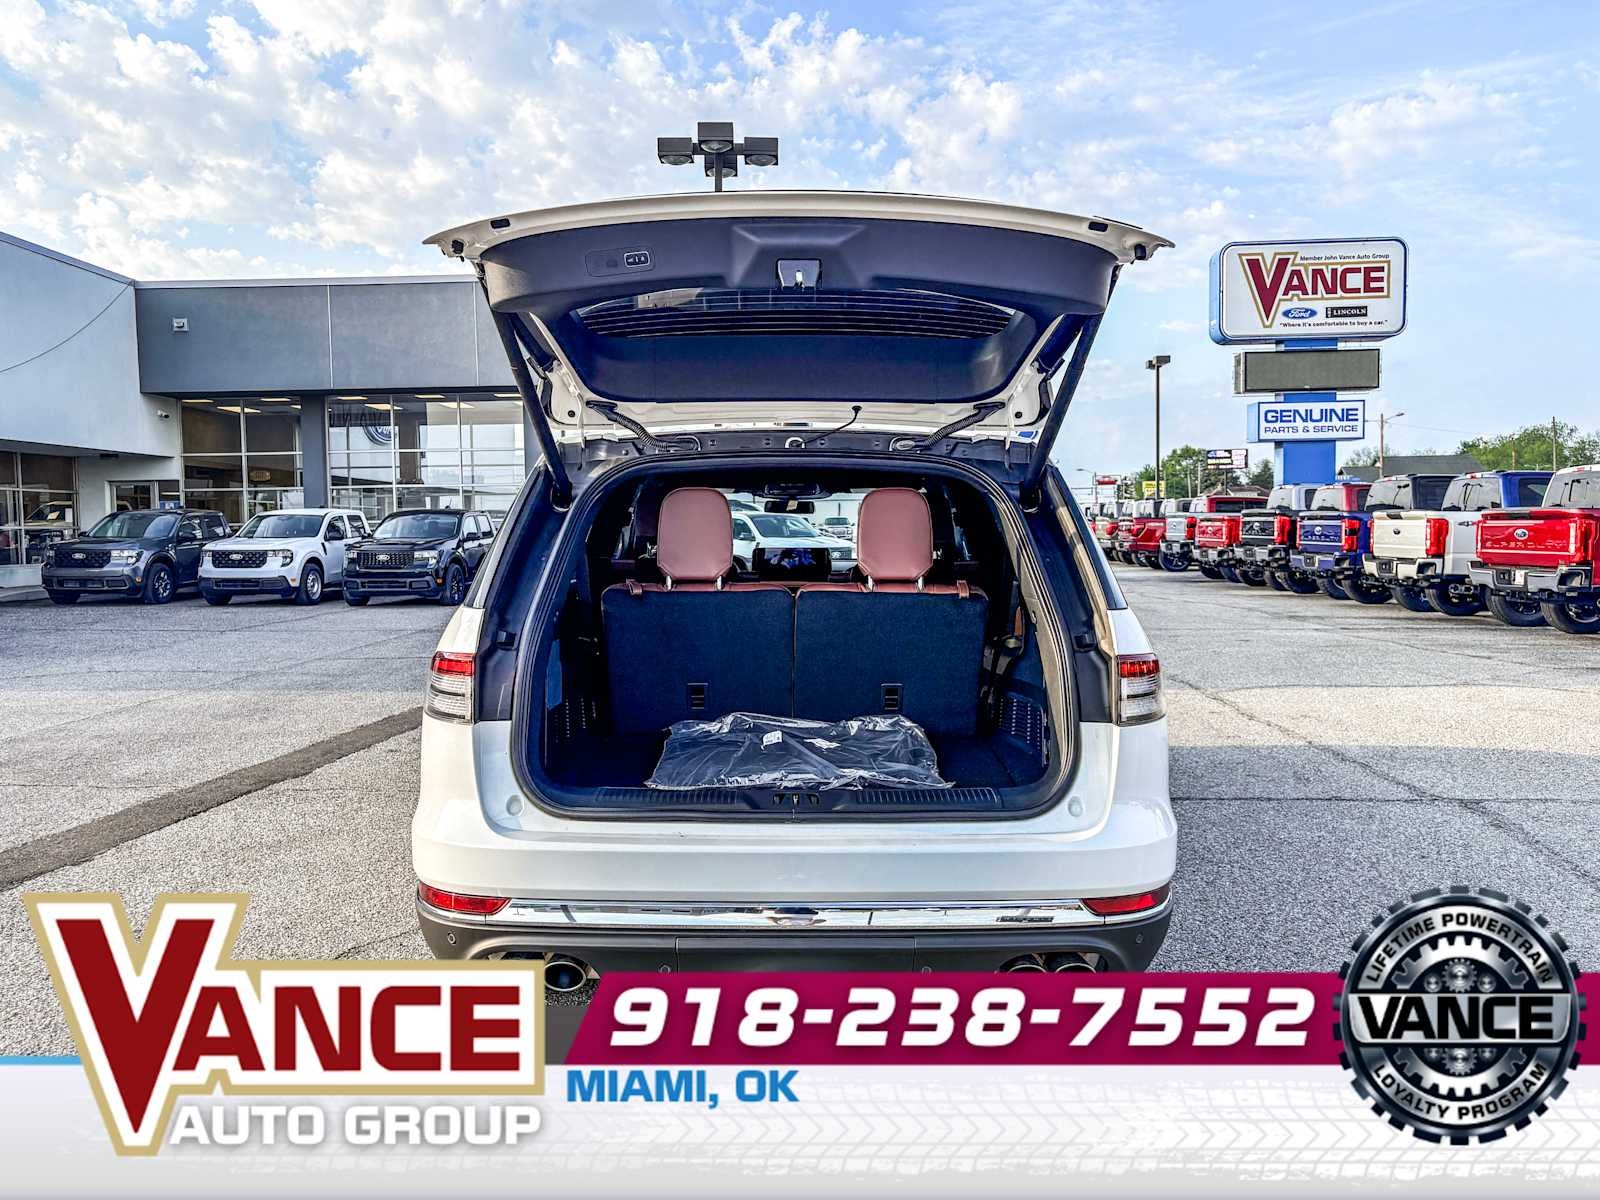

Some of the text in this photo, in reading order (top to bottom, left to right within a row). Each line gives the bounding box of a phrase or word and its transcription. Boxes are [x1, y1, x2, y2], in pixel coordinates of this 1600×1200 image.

[1289, 308, 1311, 318] Ford
[1332, 307, 1367, 316] LINCOLN
[1264, 408, 1359, 423] GENUINE
[1264, 425, 1359, 434] PARTS & SERVICE
